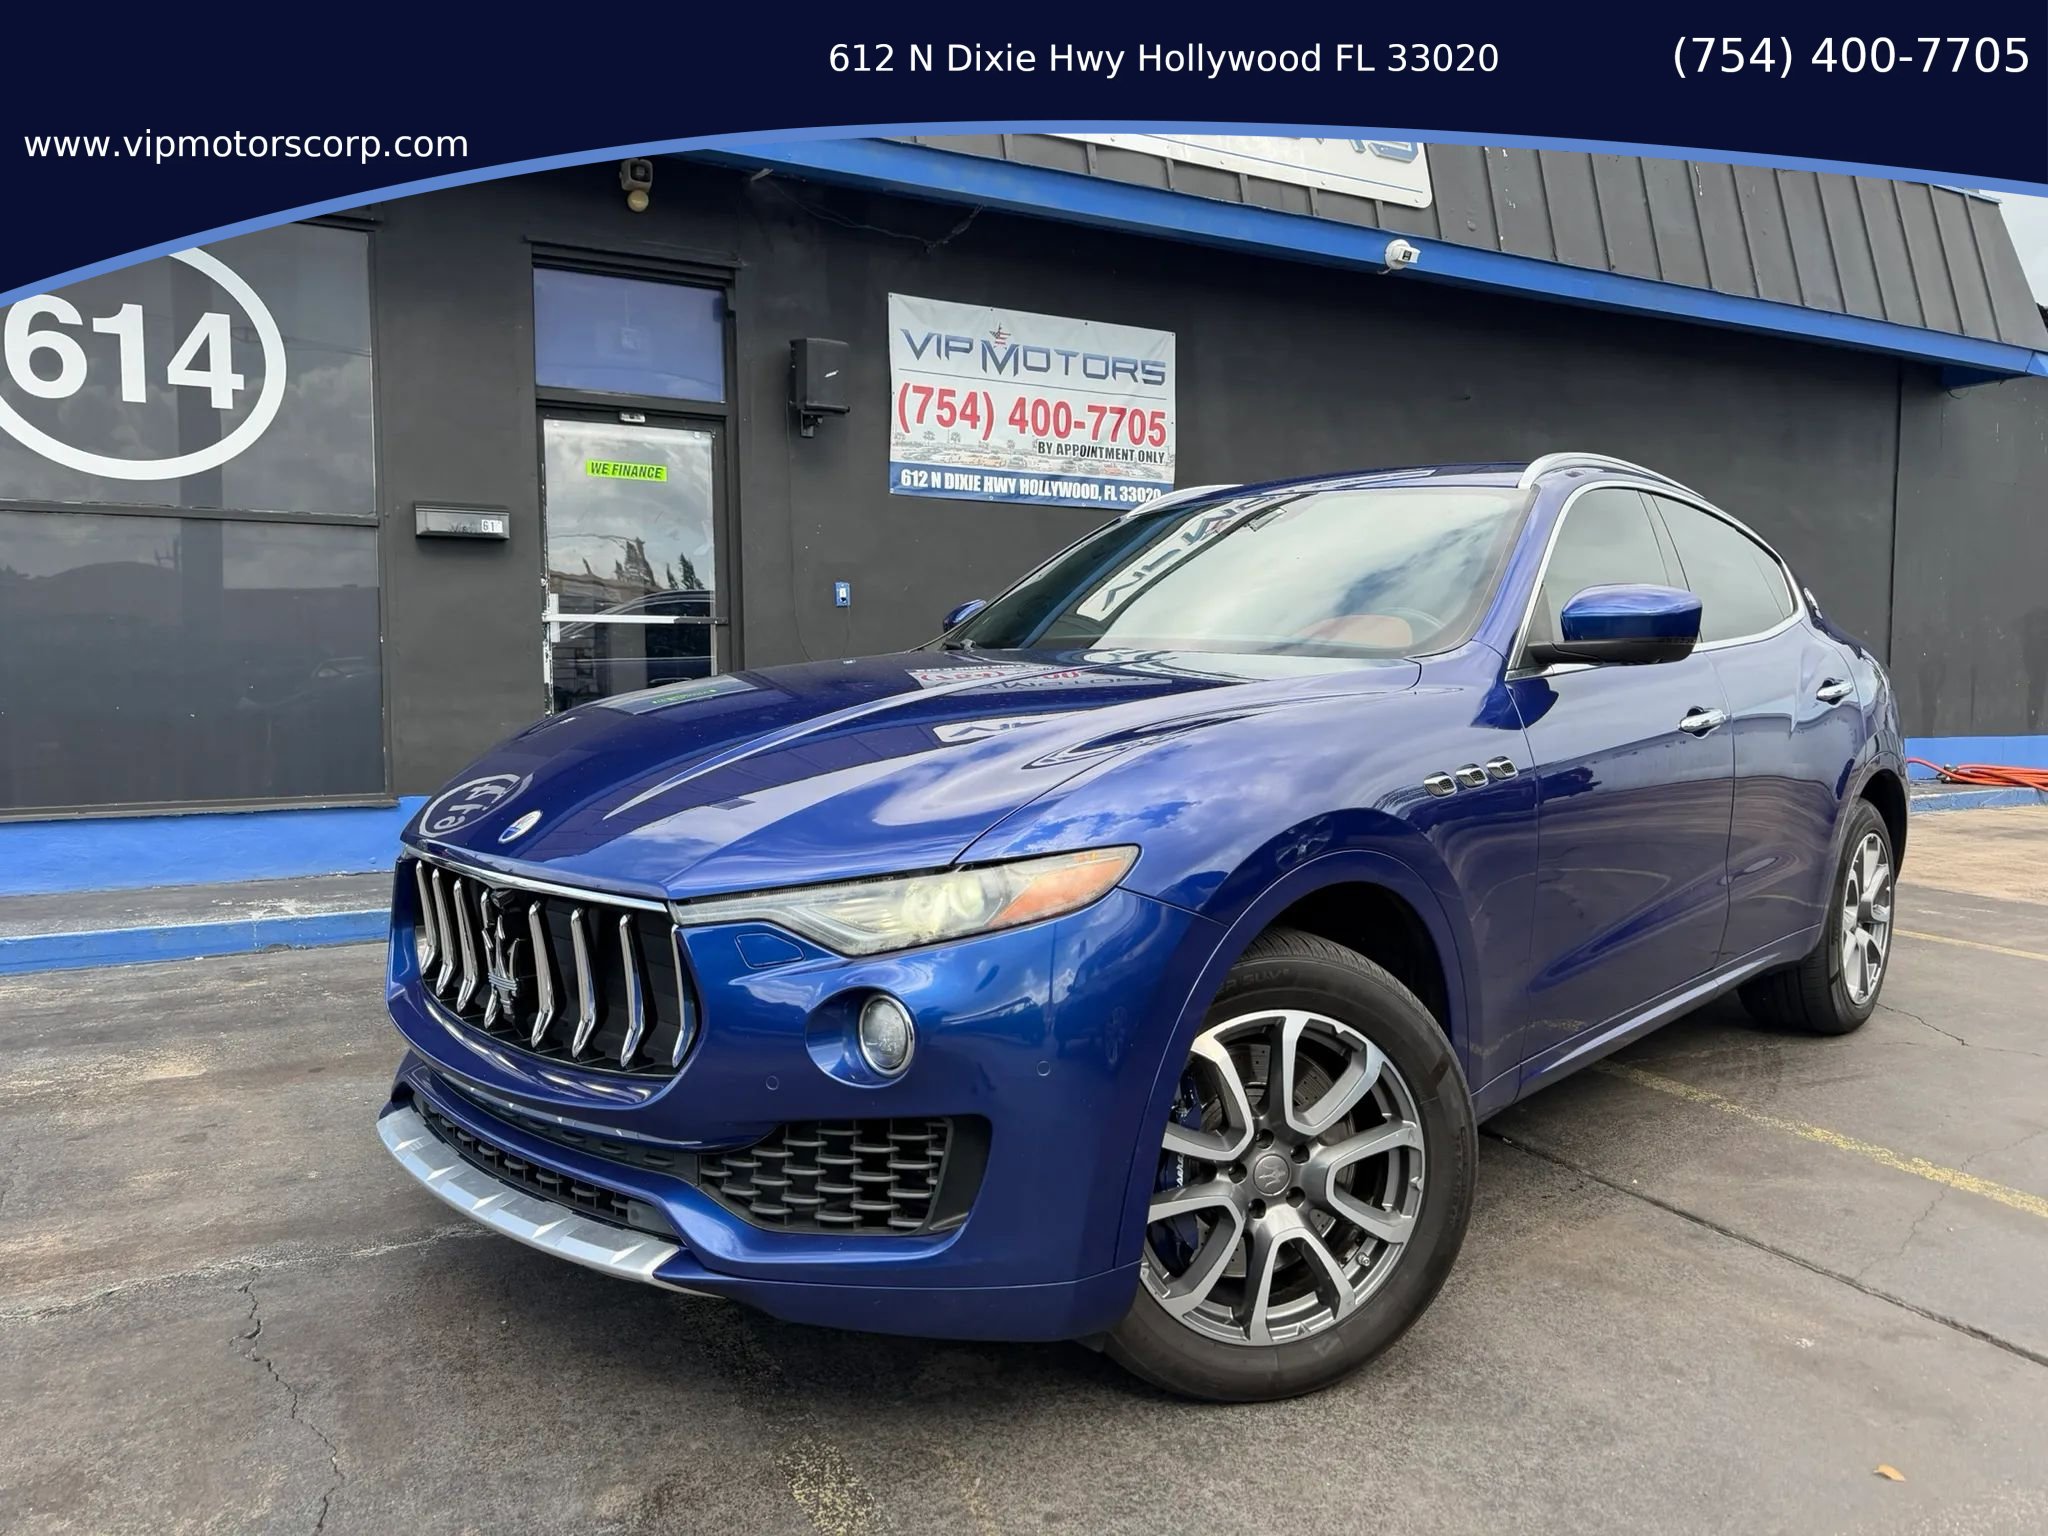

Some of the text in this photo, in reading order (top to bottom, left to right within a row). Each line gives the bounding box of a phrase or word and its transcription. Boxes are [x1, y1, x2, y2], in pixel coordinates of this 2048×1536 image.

[4, 294, 245, 410] 614
[900, 328, 974, 361] VIP
[898, 382, 1167, 447] (754) 400-7705
[1037, 441, 1166, 465] BY APPOINTMENT ONLY
[591, 462, 664, 479] WE FINANCE
[900, 469, 929, 488] 612
[931, 471, 942, 489] N
[944, 472, 981, 492] DIXIE
[983, 475, 1017, 494] HWY
[1020, 478, 1102, 502] HOLLYWOOD,
[1104, 484, 1118, 502] FL
